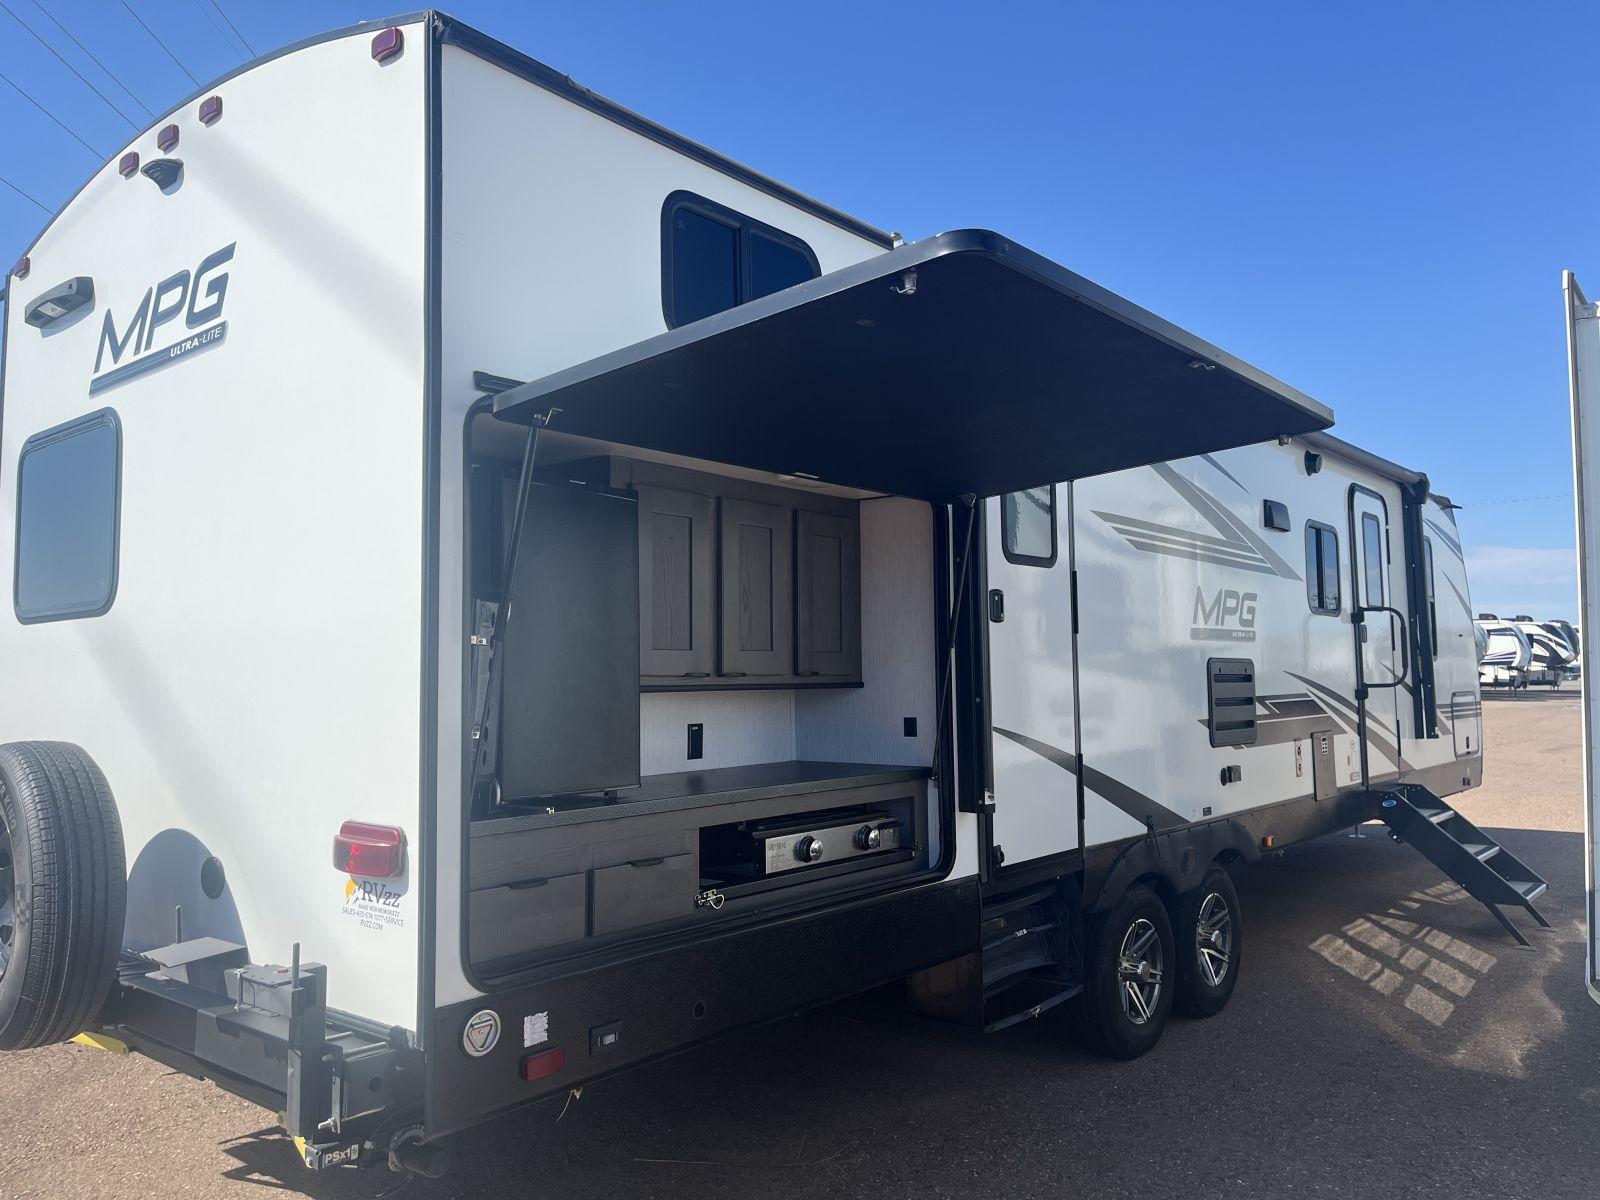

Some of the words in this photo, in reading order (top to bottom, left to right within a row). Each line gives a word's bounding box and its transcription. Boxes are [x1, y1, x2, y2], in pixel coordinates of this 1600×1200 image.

[93, 241, 237, 375] MPG
[170, 326, 223, 358] ULTRA-LITE
[1192, 585, 1258, 628] MPG
